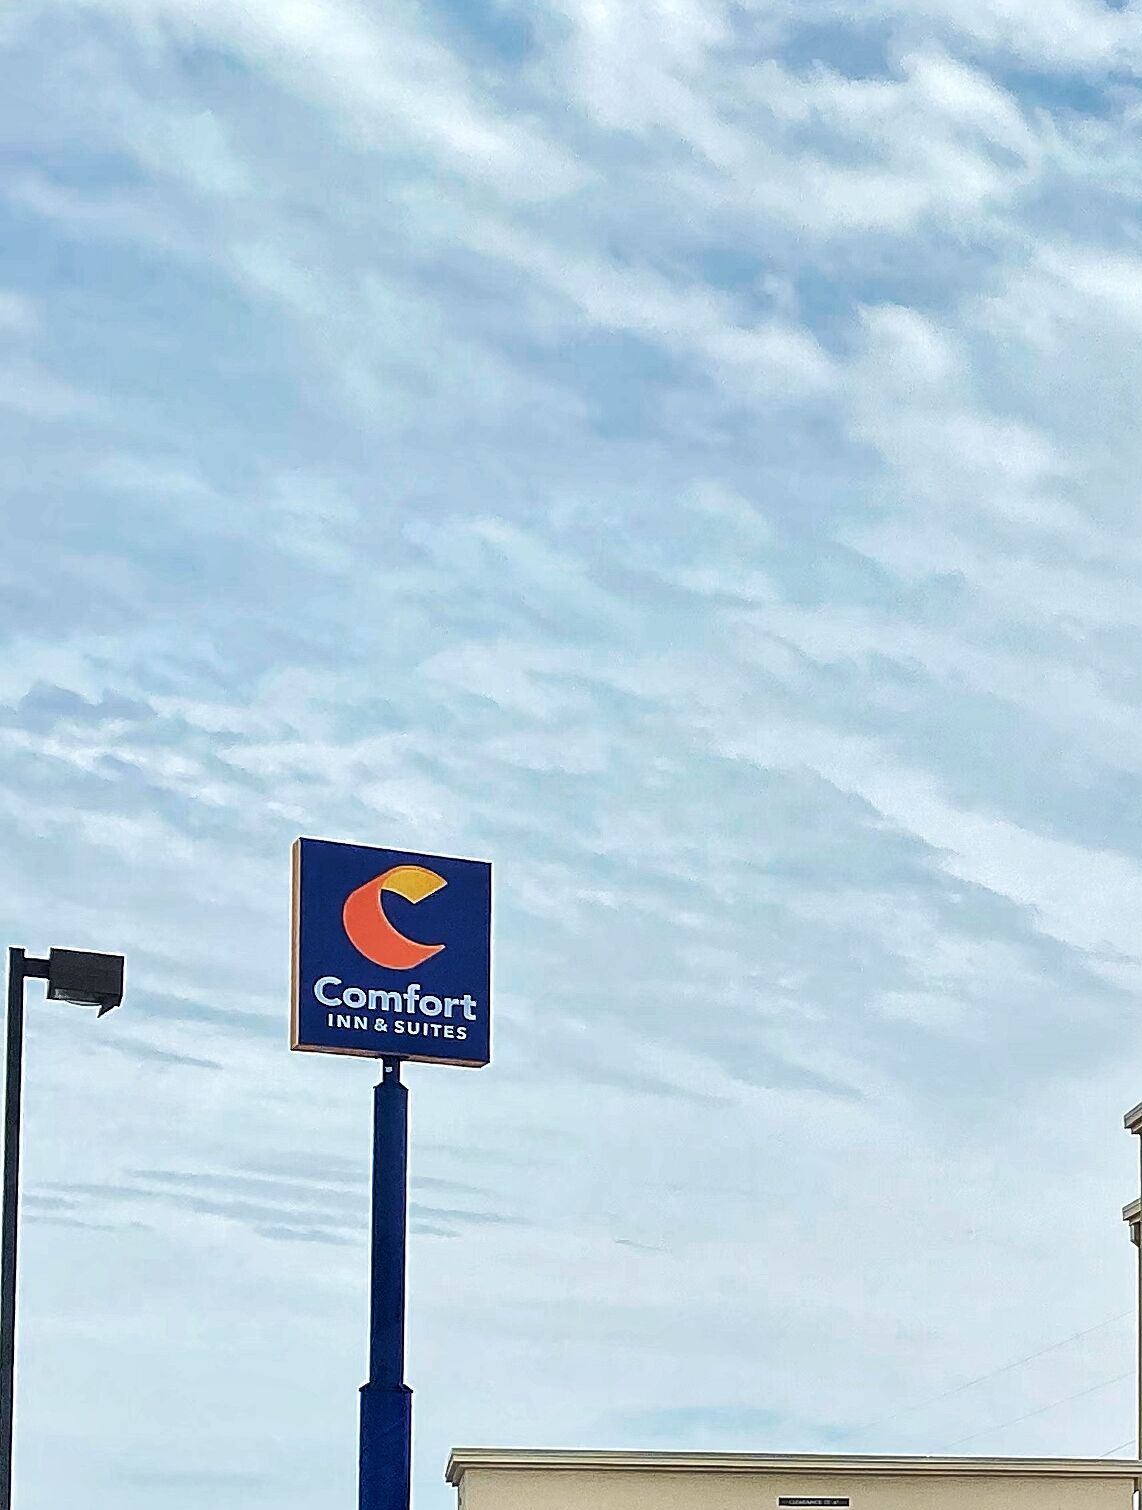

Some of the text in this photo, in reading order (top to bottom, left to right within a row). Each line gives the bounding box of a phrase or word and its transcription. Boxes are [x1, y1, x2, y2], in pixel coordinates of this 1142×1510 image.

[313, 976, 477, 1021] Comfort
[328, 1013, 467, 1040] INN & SUITES
